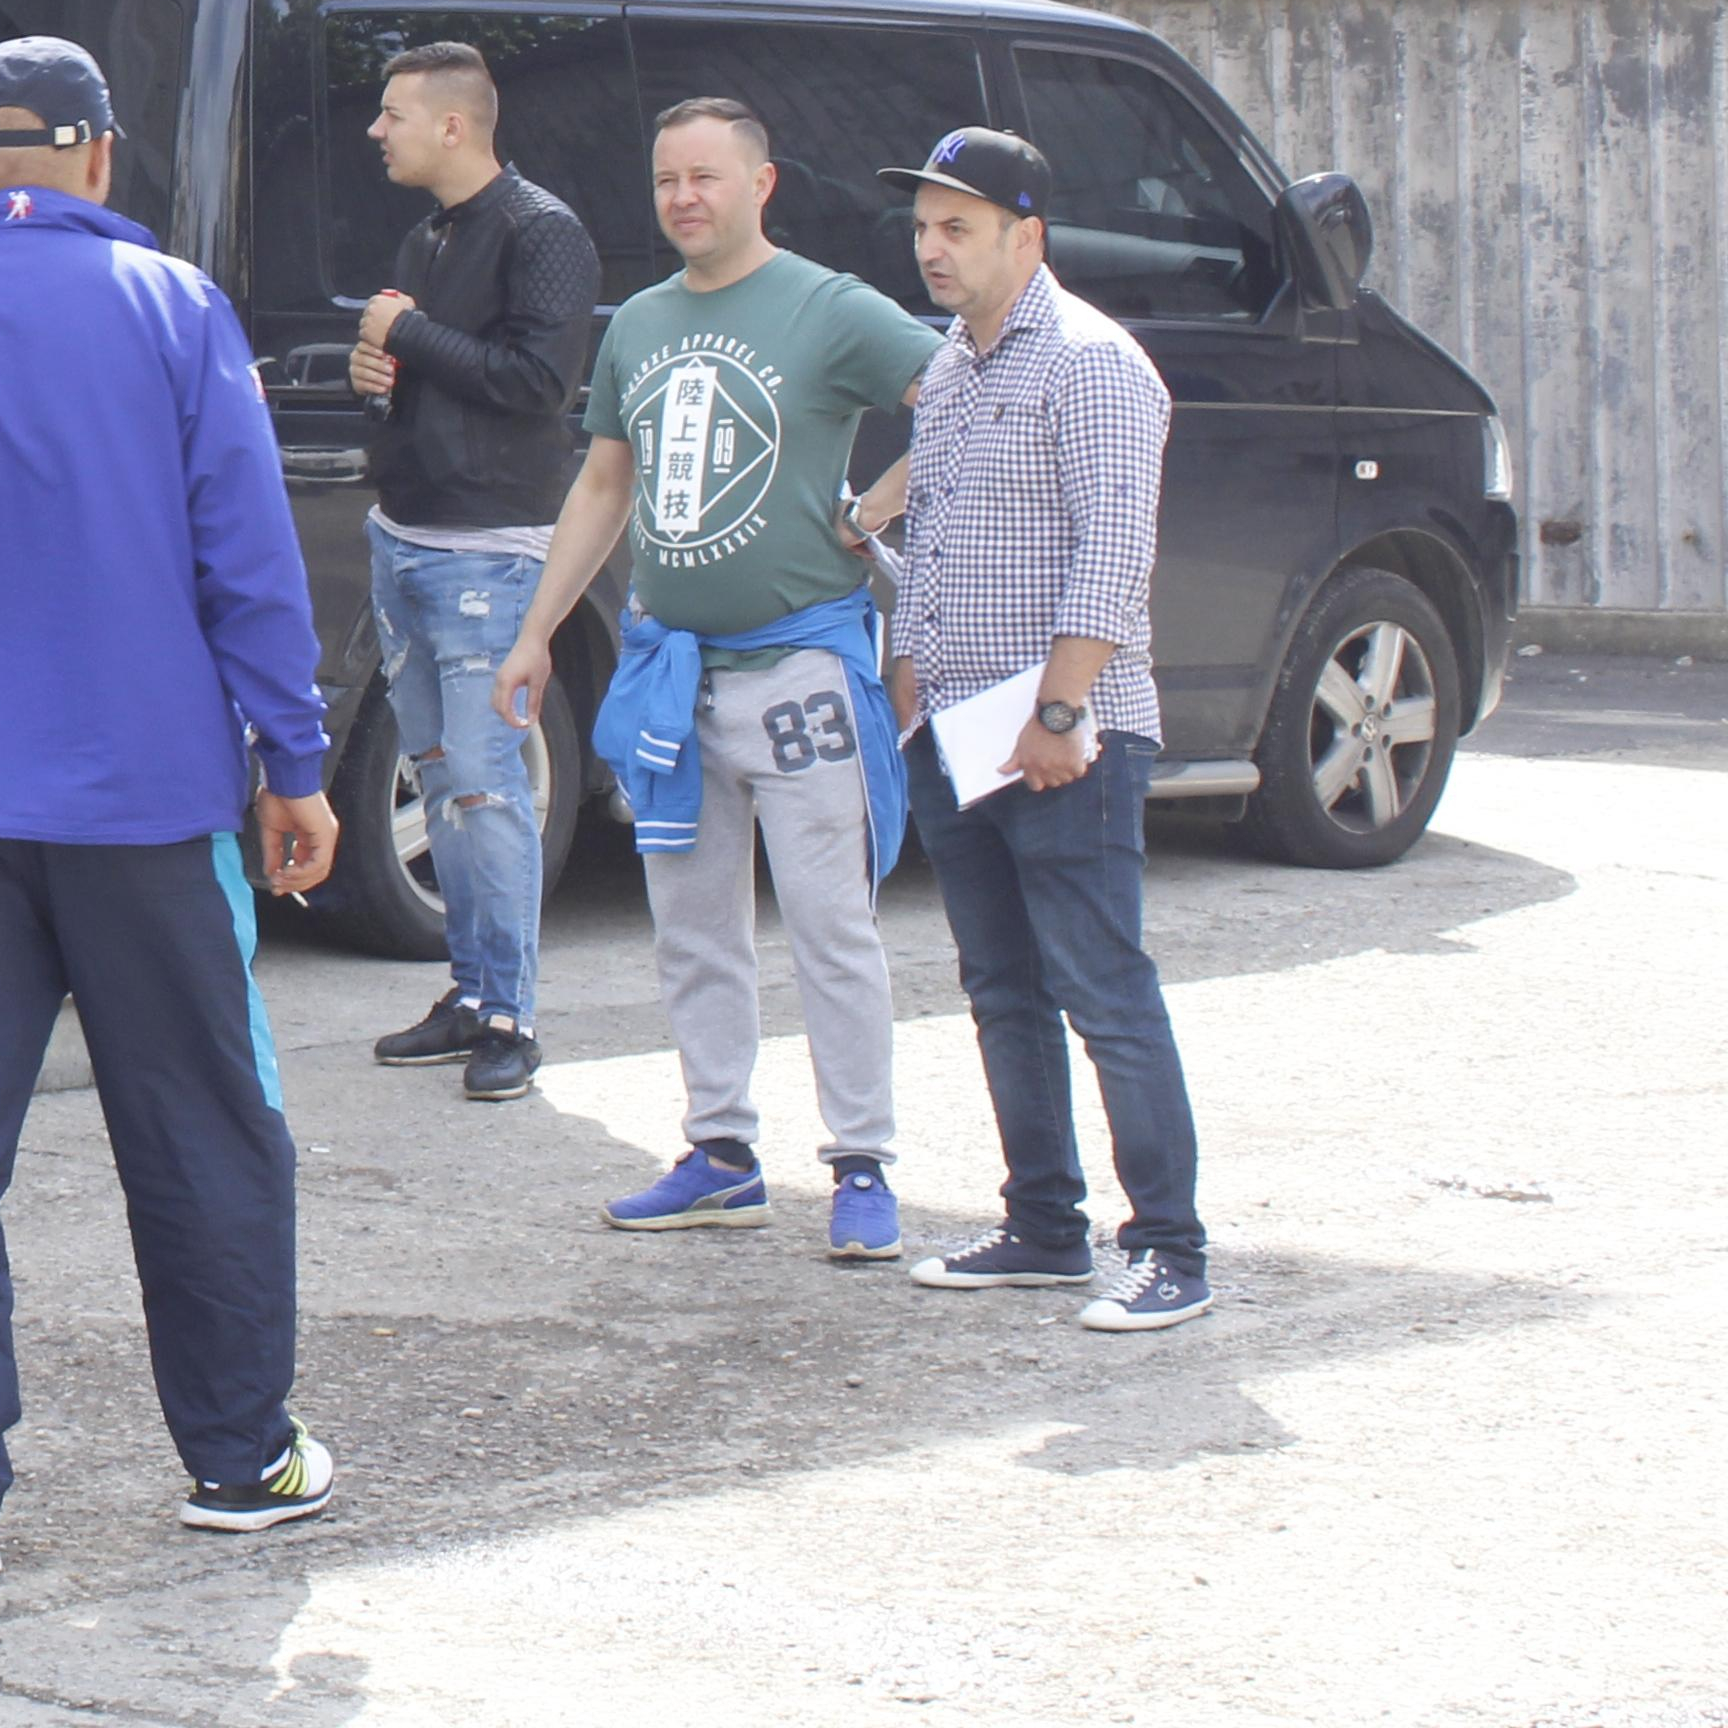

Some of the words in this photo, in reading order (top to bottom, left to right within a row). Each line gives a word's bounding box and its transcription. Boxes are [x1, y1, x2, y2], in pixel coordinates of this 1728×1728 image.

[680, 333, 756, 365] APPAREL
[712, 427, 735, 465] 89
[659, 513, 768, 568] MCMLXXXIX
[762, 690, 857, 773] 83
